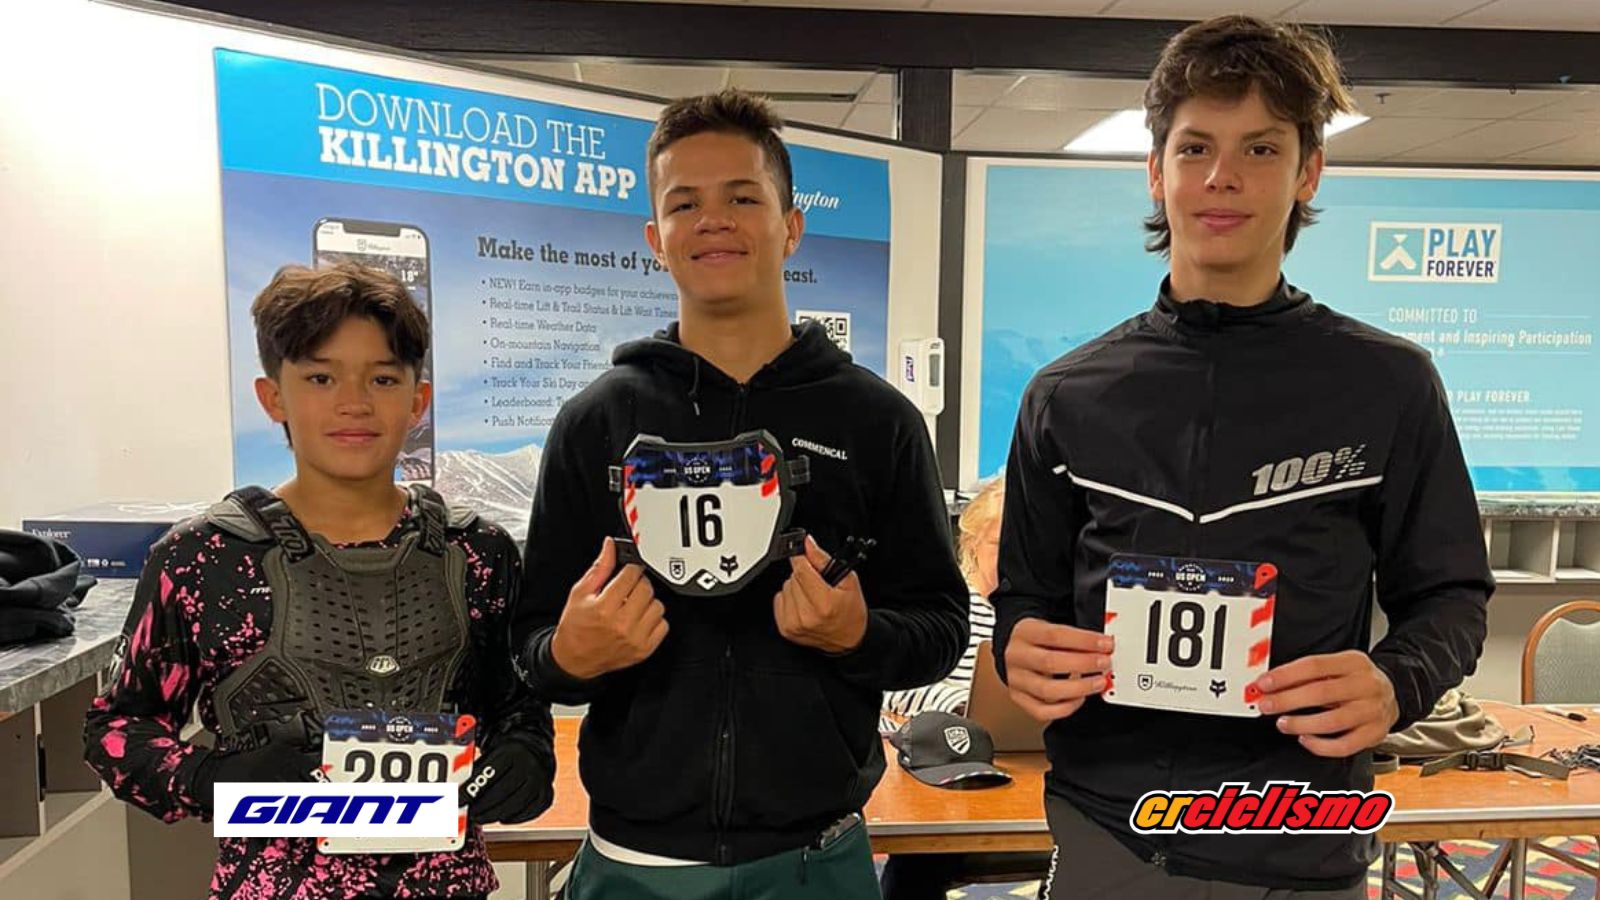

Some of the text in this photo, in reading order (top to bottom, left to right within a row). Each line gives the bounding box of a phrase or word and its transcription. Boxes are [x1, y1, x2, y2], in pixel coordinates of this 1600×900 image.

[315, 83, 606, 161] DOWNLOAD THE
[318, 126, 637, 200] KILLINGTON APP
[478, 236, 669, 276] Make the most of yo
[1428, 228, 1497, 258] PLAY
[783, 265, 818, 285] east.
[1427, 259, 1495, 277] FOREVER
[1388, 307, 1477, 324] COMMITTED TO
[1438, 330, 1460, 345] and
[1463, 330, 1515, 347] Inspiring
[1518, 329, 1592, 347] Participation
[1457, 389, 1481, 402] PLAY
[1486, 390, 1530, 403] FOREVER
[791, 437, 848, 461] COMMENCAL
[1252, 443, 1367, 497] 100%
[679, 494, 724, 548] 16
[1146, 599, 1228, 671] 181
